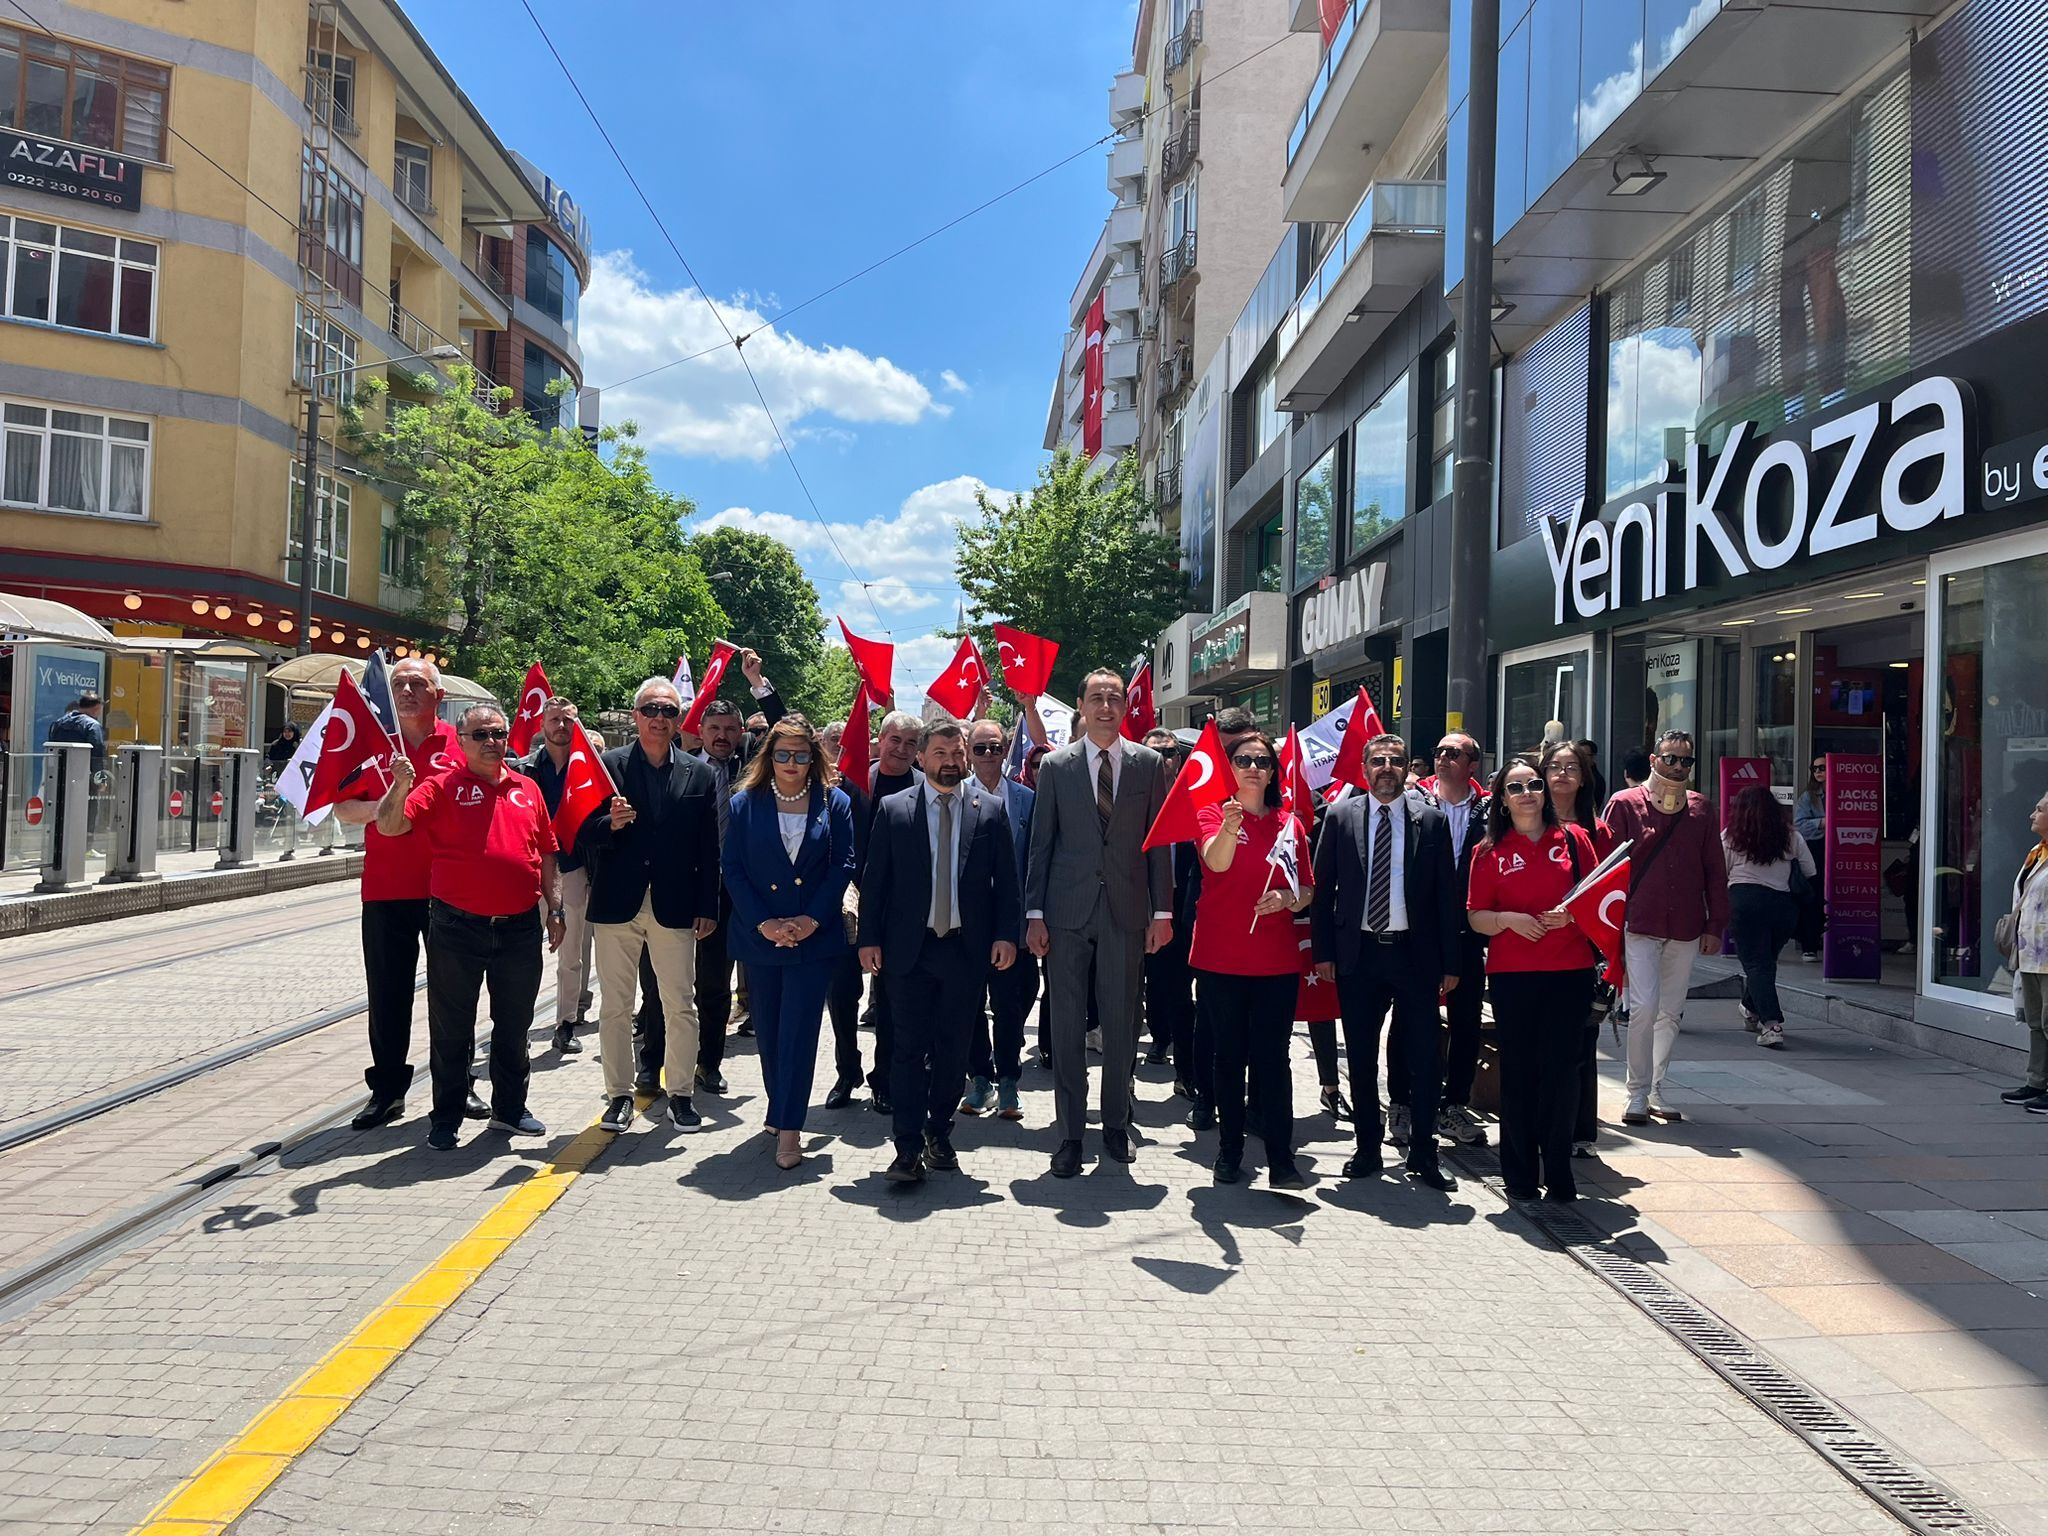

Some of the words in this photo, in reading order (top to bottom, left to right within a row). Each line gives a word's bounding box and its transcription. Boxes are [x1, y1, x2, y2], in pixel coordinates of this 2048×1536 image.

[9, 140, 124, 182] AZAFLI
[7, 172, 45, 188] 0222
[49, 181, 77, 194] 230
[82, 188, 100, 199] 20
[104, 193, 122, 204] 50
[1985, 462, 2021, 501] by
[1302, 562, 1386, 655] GÜNAY
[1838, 801, 1878, 811] JONES
[1835, 861, 1878, 871] GUESS
[1835, 886, 1878, 895] LUFIAN
[1834, 910, 1878, 918] NAUTICA
